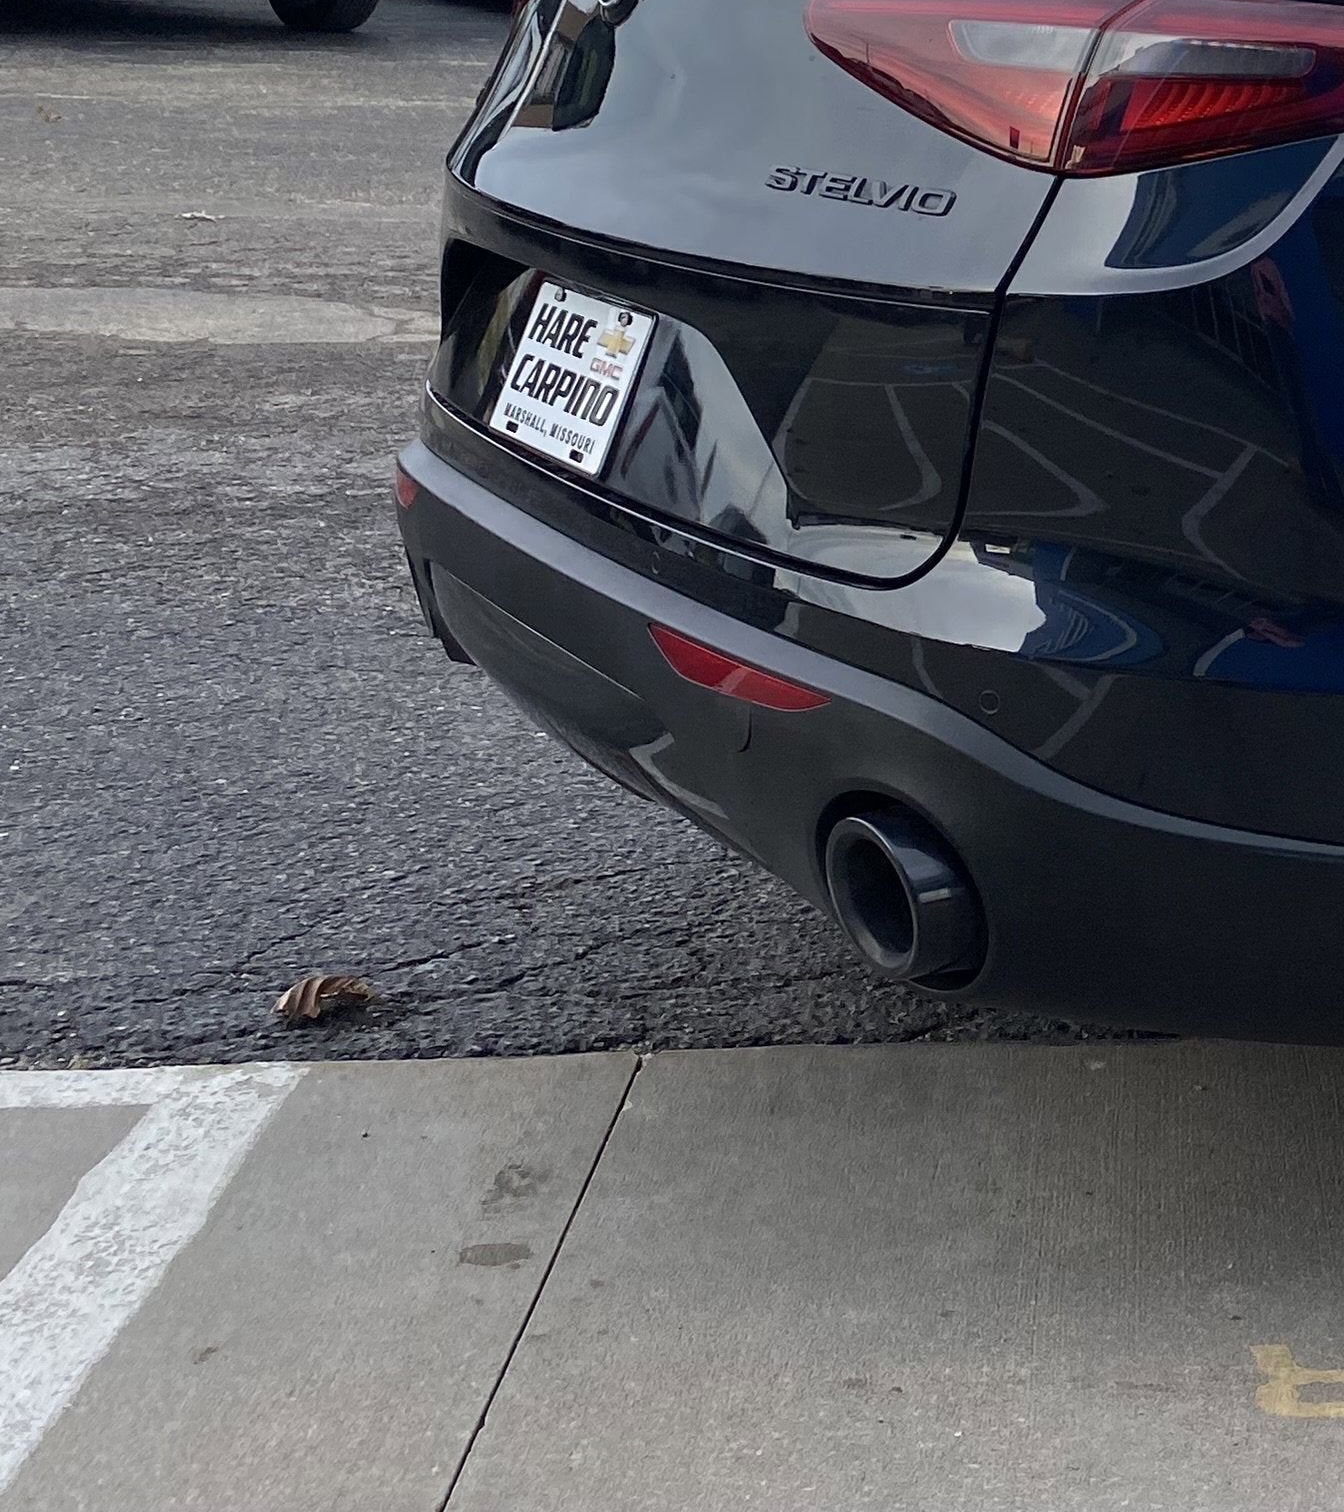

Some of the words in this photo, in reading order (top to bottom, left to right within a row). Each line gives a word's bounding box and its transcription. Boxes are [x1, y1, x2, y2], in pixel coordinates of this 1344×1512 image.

[765, 166, 958, 217] STELVIO
[528, 302, 599, 359] HARE
[510, 353, 621, 427] CARPINO
[589, 357, 623, 381] GMC
[503, 402, 548, 437] MARSHALL,
[549, 422, 596, 455] MISSOURI
